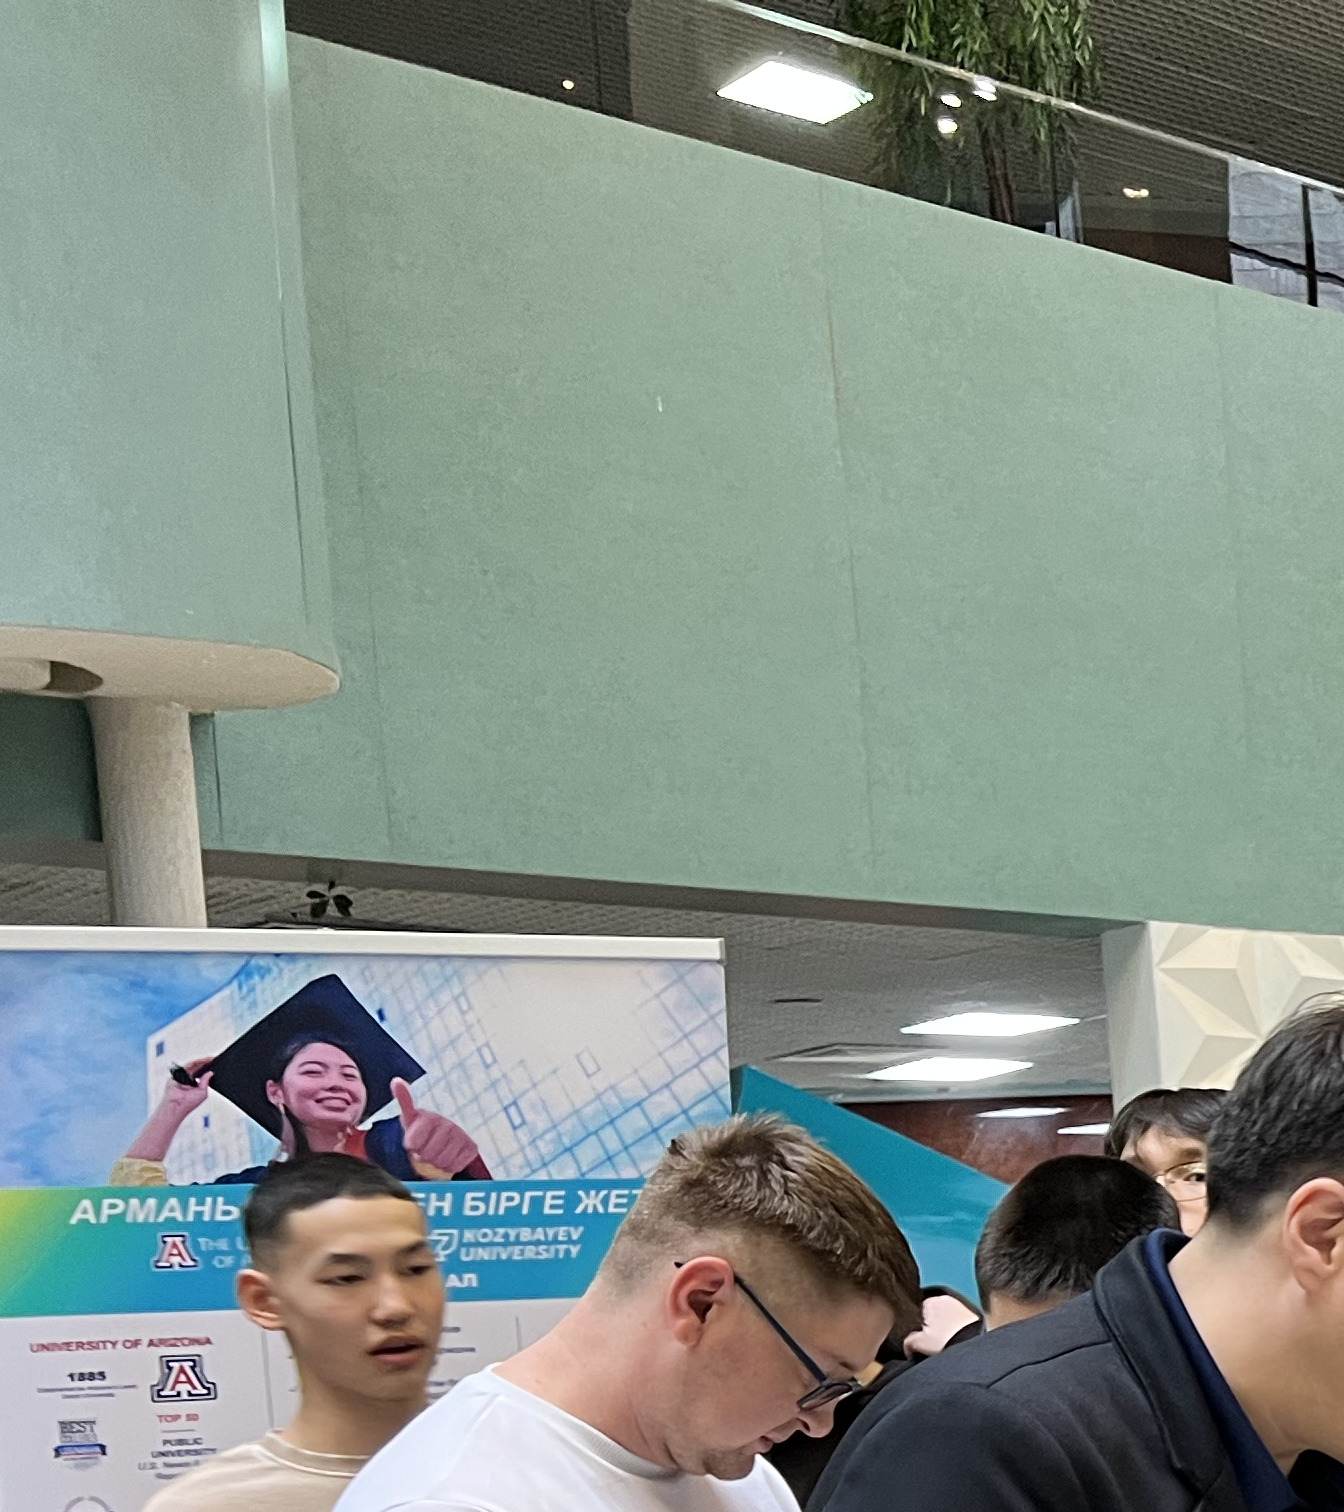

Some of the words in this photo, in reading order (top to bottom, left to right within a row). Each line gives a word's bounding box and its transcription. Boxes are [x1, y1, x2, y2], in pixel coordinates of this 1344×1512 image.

[462, 1190, 566, 1217] БІРГЕ
[462, 1226, 584, 1244] KOZYBAYEV
[459, 1244, 582, 1260] UNIVERSITY
[29, 1339, 119, 1354] UNIVERSITY
[123, 1338, 142, 1350] OF
[147, 1336, 214, 1349] ARIZONA
[67, 1370, 107, 1383] 1885
[156, 1413, 182, 1424] TOP
